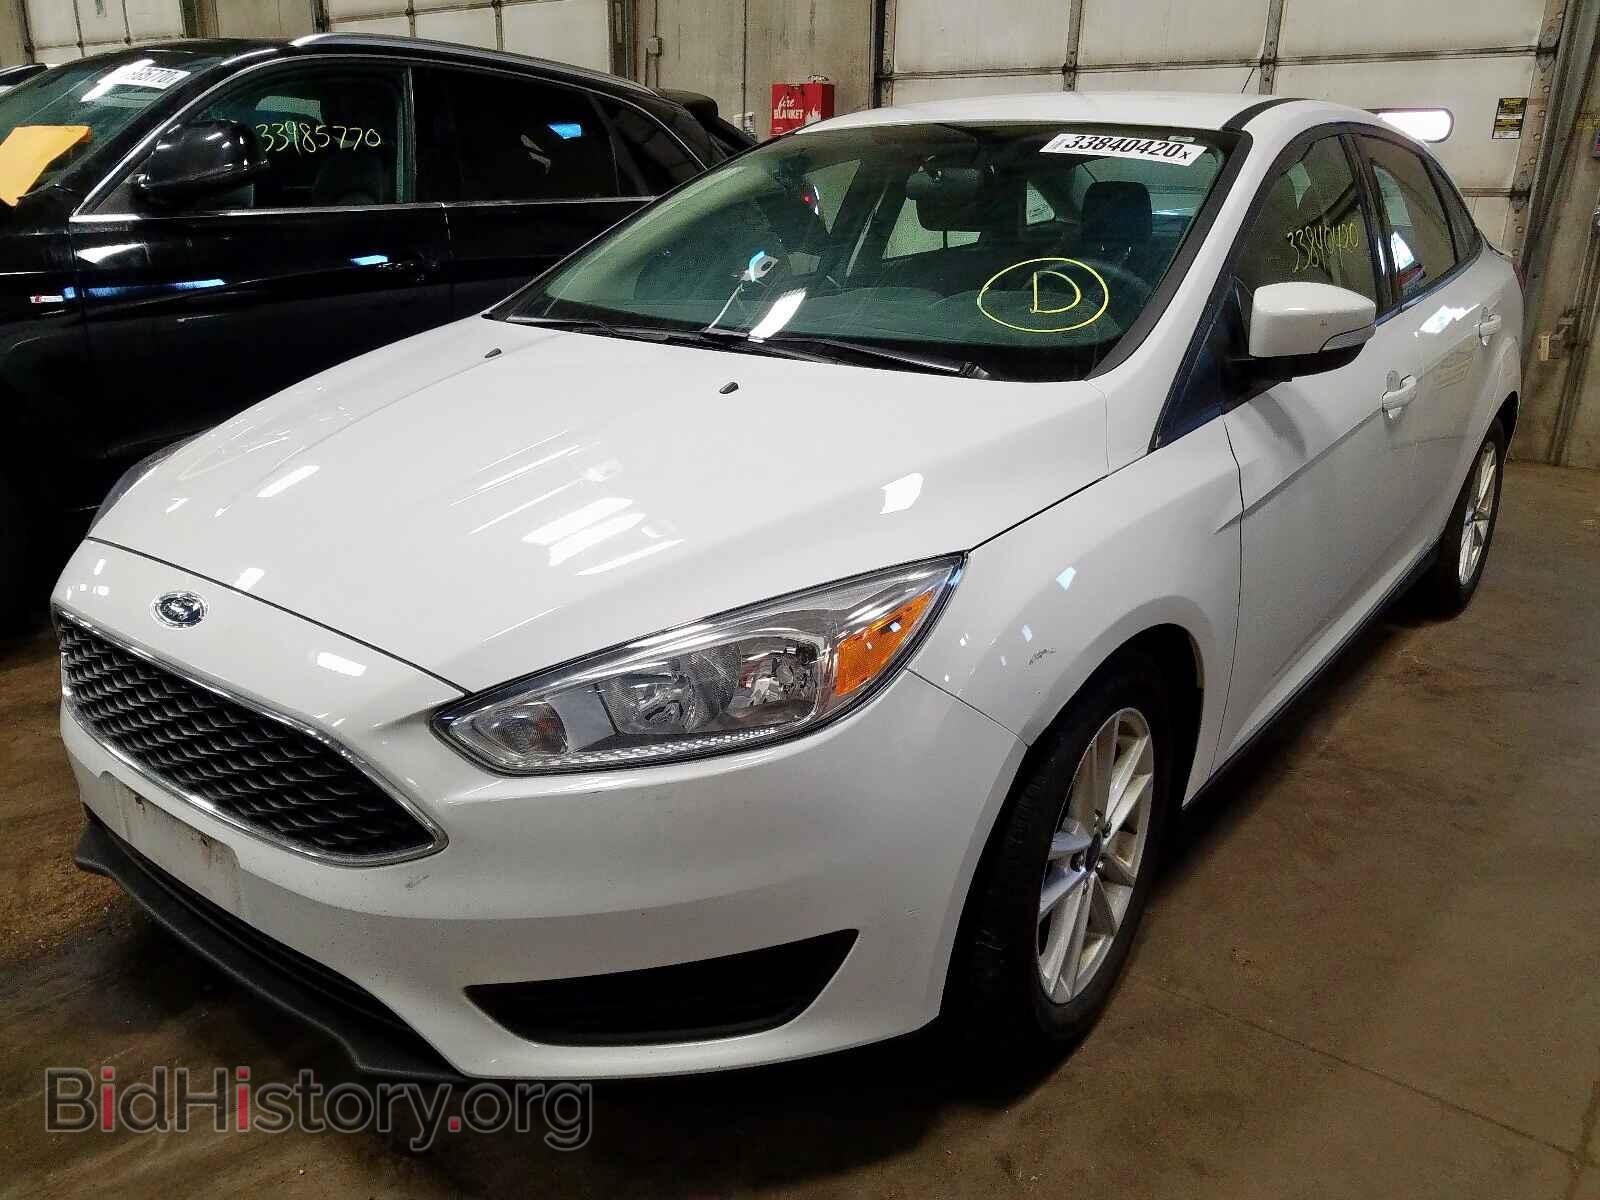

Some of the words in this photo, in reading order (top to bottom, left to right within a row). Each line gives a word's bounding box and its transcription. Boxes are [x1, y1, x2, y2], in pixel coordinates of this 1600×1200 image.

[773, 109, 804, 120] BLANKET
[255, 120, 381, 156] 33985770
[1030, 270, 1081, 314] D
